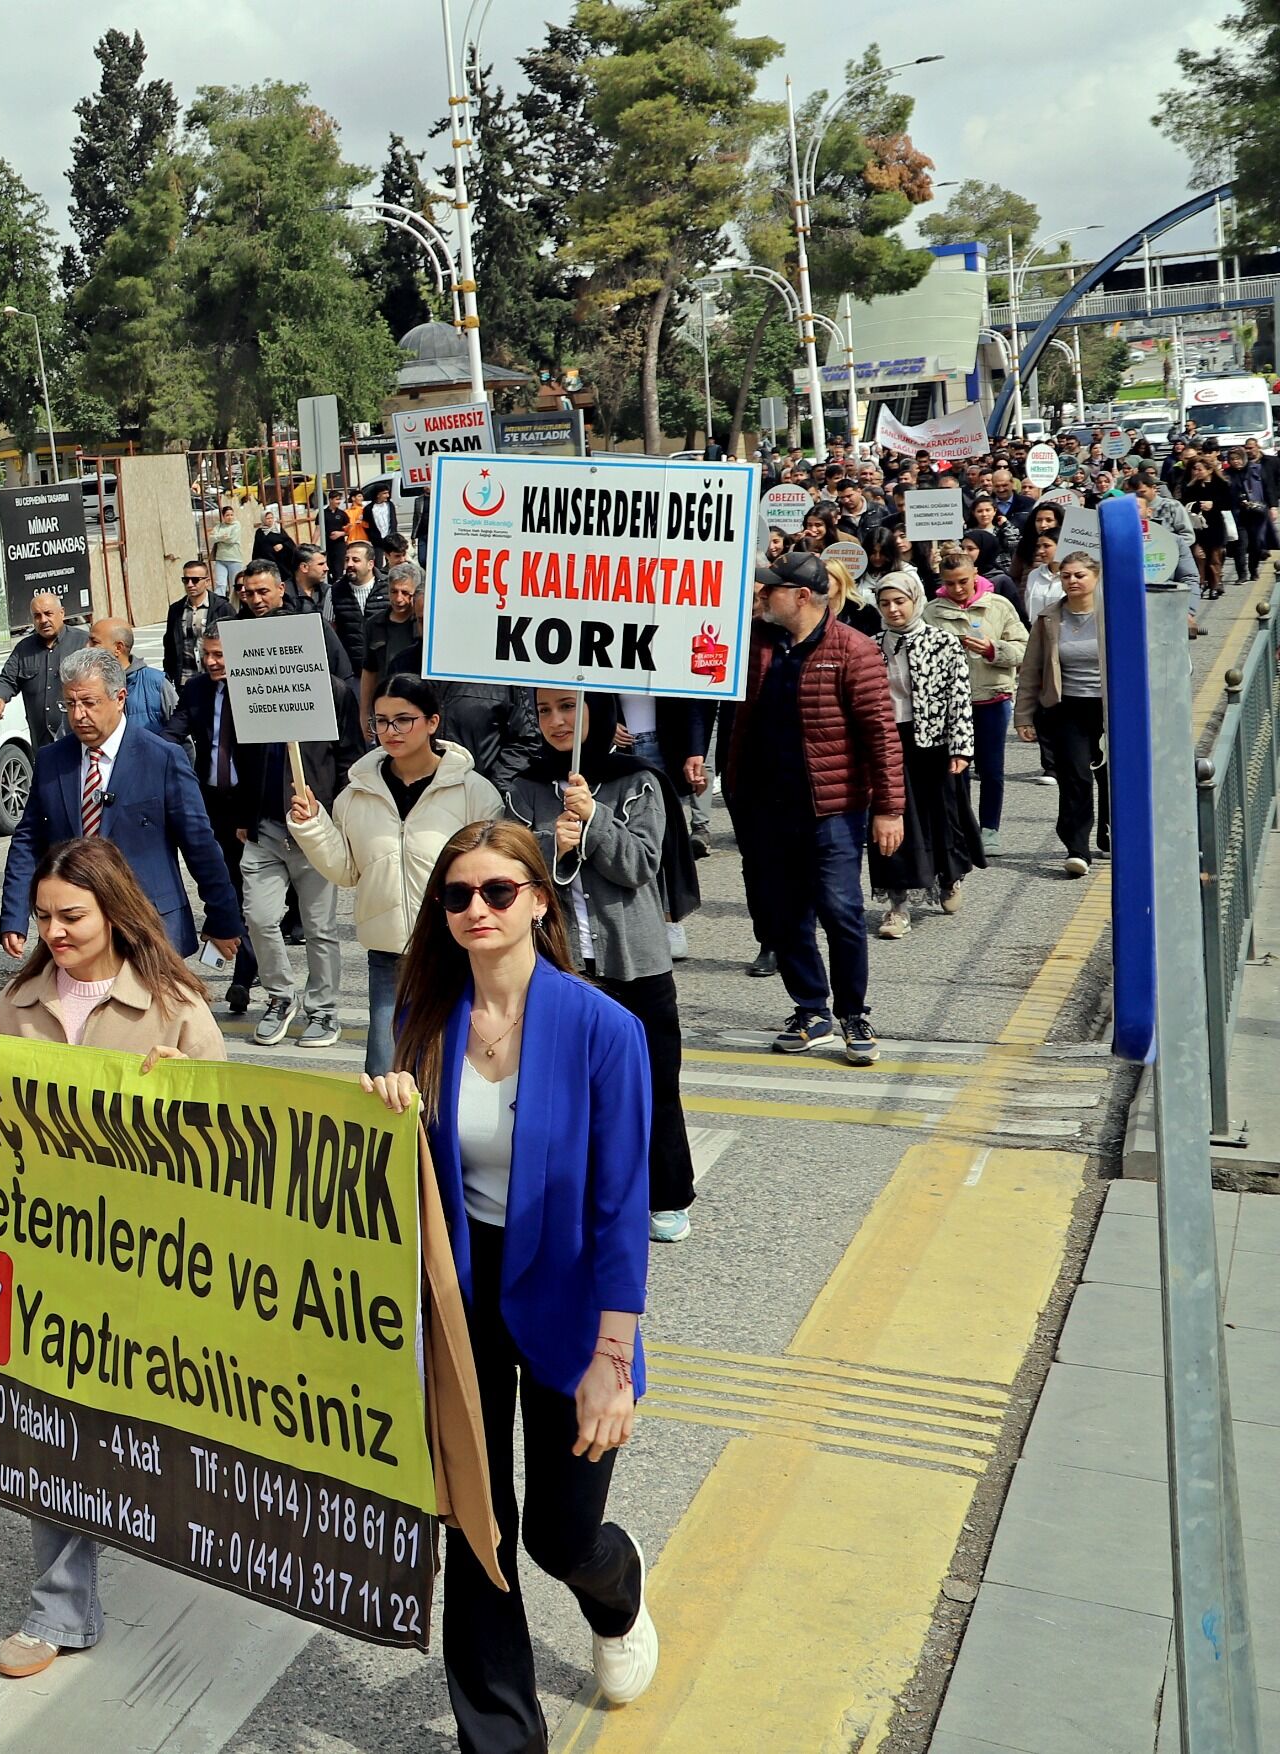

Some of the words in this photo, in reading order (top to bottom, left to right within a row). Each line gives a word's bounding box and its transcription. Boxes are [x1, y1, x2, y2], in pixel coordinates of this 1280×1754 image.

[424, 408, 485, 432] KANSERSİZ
[521, 429, 572, 442] KATLADIK
[28, 515, 59, 535] MİMAR
[521, 486, 660, 540] KANSERDEN
[666, 478, 736, 543] DEĞİL
[8, 541, 42, 561] GAMZE
[42, 536, 86, 555] ONAKBAŞ
[452, 547, 510, 610] GEÇ
[520, 551, 724, 607] KALMAKTAN
[243, 646, 265, 658] ANNE
[266, 647, 278, 656] VE
[279, 645, 304, 656] BEBEK
[495, 615, 659, 671] KORK
[230, 663, 278, 678] ARASINDAKİ
[279, 662, 325, 674] DUYGUSAL
[246, 683, 265, 695] BAĞ
[266, 684, 290, 694] DAHA
[292, 683, 312, 692] KISA
[248, 702, 278, 714] SÜREDE
[279, 701, 315, 713] KURULUR
[12, 1076, 279, 1211] KALMAKTAN
[285, 1107, 403, 1246] KORK
[229, 1251, 279, 1322] ve
[291, 1257, 404, 1352] Aile
[17, 1283, 399, 1468] Yaptırabilirsiniz
[9, 1391, 66, 1449] Yataklı
[128, 1427, 162, 1476] kat
[190, 1446, 219, 1494] Tlf
[234, 1458, 247, 1503] 0
[252, 1466, 312, 1538] (414)
[318, 1488, 357, 1543] 318
[363, 1503, 386, 1556] 61
[393, 1515, 420, 1569] 61
[29, 1460, 113, 1528] Poliklinik
[118, 1492, 157, 1543] Katı
[187, 1521, 214, 1568] Tlf
[229, 1532, 242, 1574] 0
[247, 1537, 304, 1609] (414)
[310, 1567, 352, 1617] 317
[358, 1579, 383, 1629] 11
[389, 1592, 422, 1635] 22
